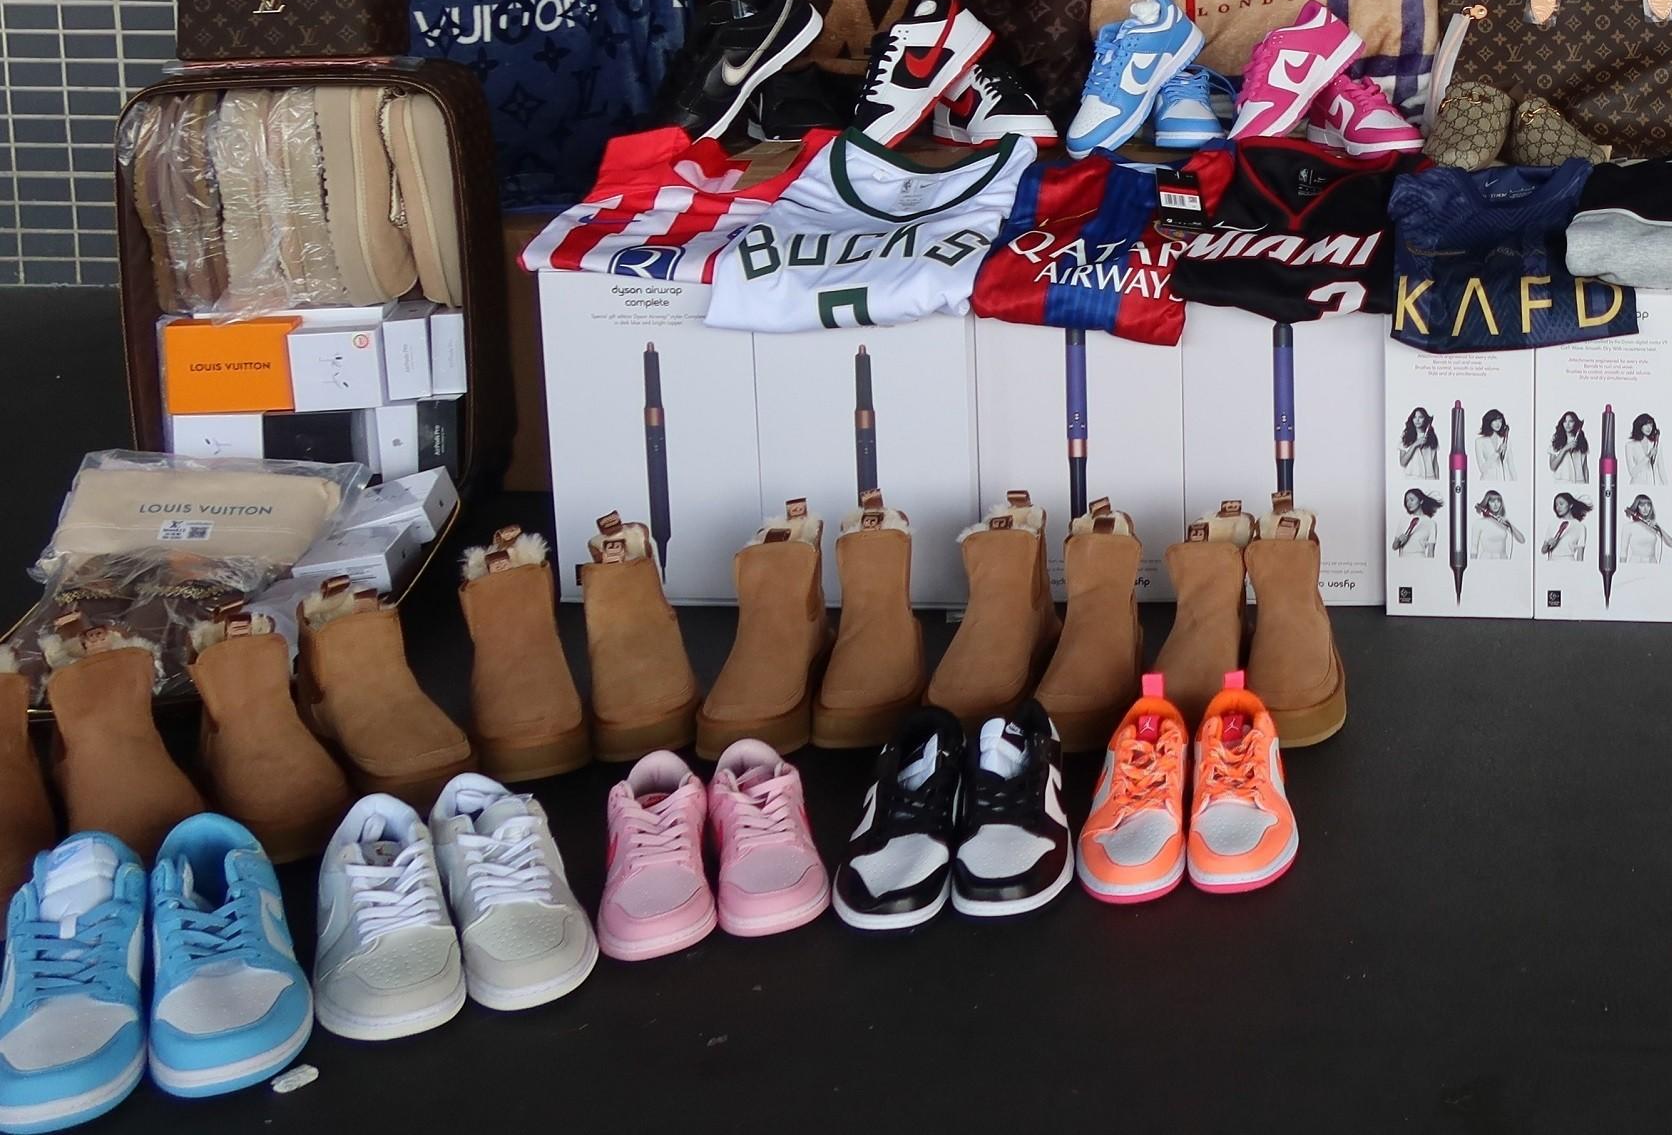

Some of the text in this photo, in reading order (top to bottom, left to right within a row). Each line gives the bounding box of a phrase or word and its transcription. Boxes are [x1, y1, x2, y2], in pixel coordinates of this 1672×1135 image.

[736, 222, 992, 280] BUCKS
[1008, 230, 1188, 267] QATAR
[1187, 230, 1384, 266] MIAMI
[611, 285, 682, 297] dyson airwrap
[625, 298, 670, 307] complete
[190, 361, 272, 372] LOUIS VUITTON
[140, 504, 273, 515] LOUIS VUITTON
